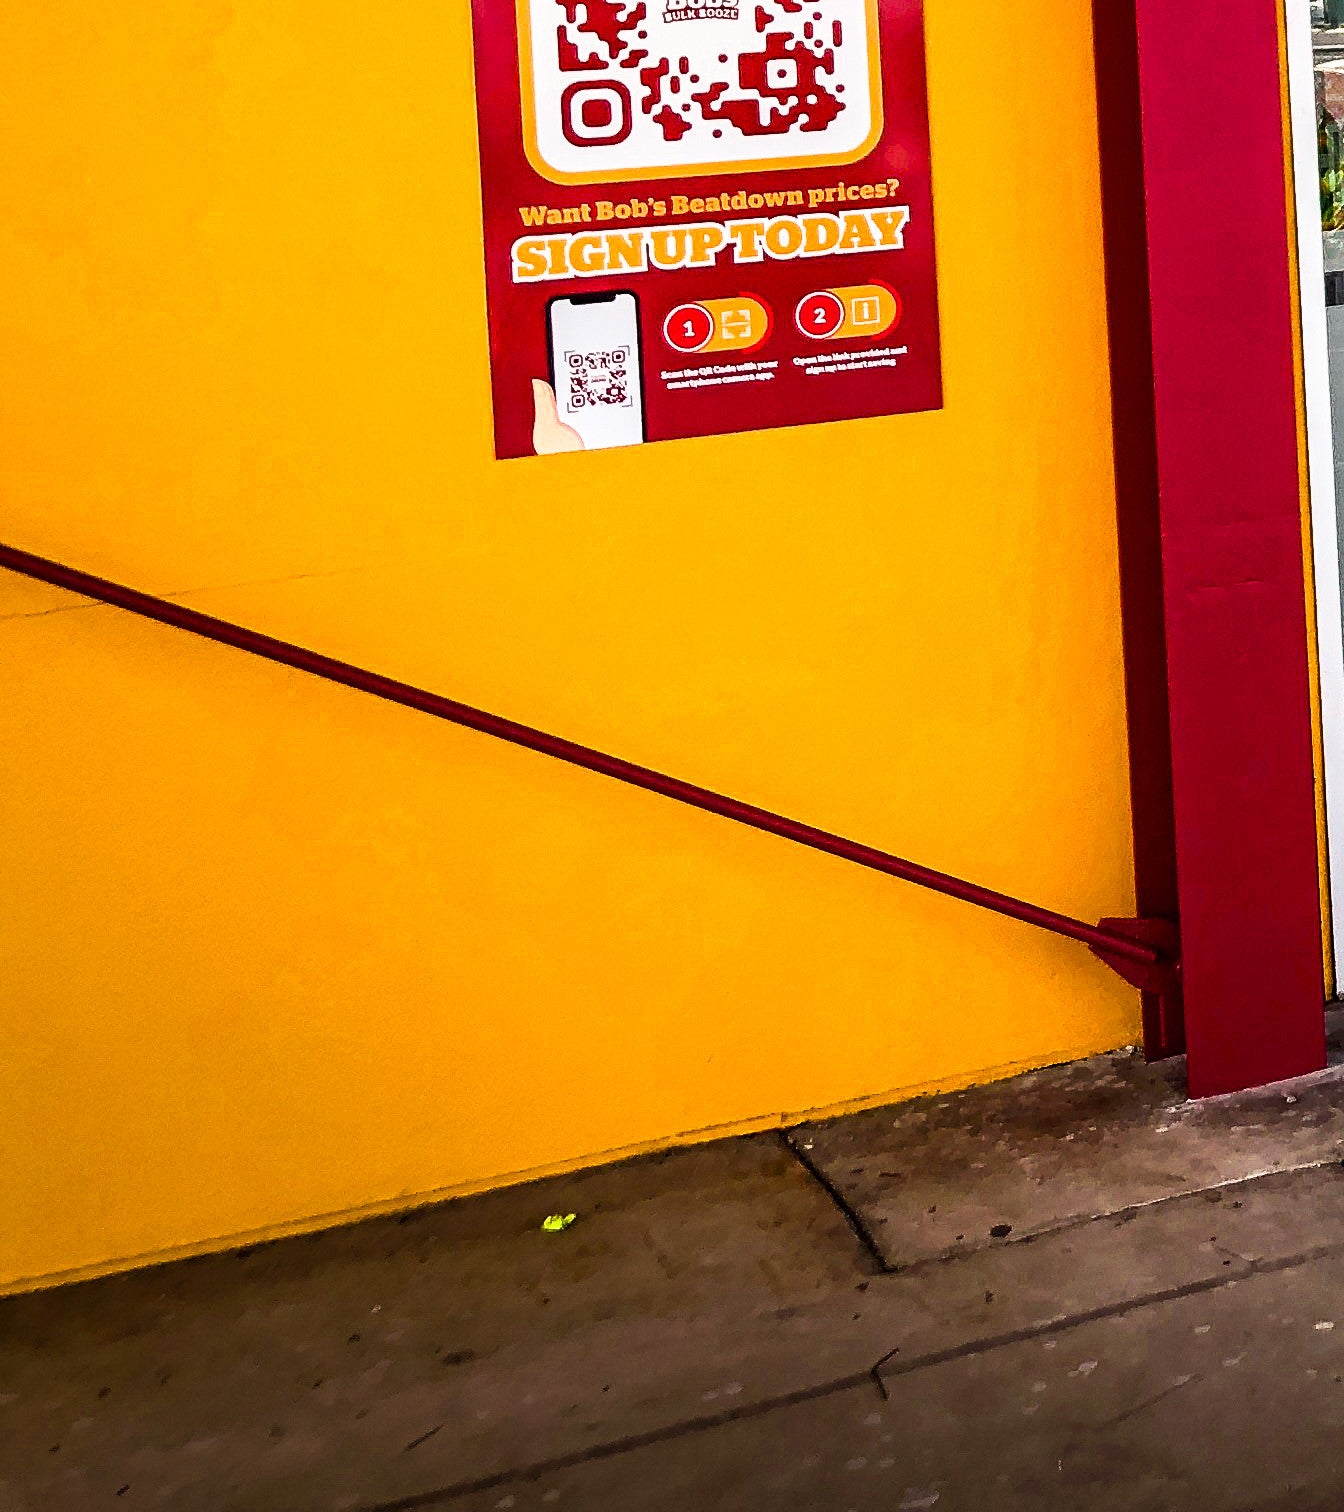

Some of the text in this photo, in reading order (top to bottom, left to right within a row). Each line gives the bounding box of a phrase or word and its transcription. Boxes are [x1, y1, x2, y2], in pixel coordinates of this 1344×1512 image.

[518, 178, 900, 227] Want Bob's Beatdown prices?
[513, 206, 909, 283] SIGN UP TODAY
[682, 320, 696, 336] 1
[813, 307, 827, 323] 2
